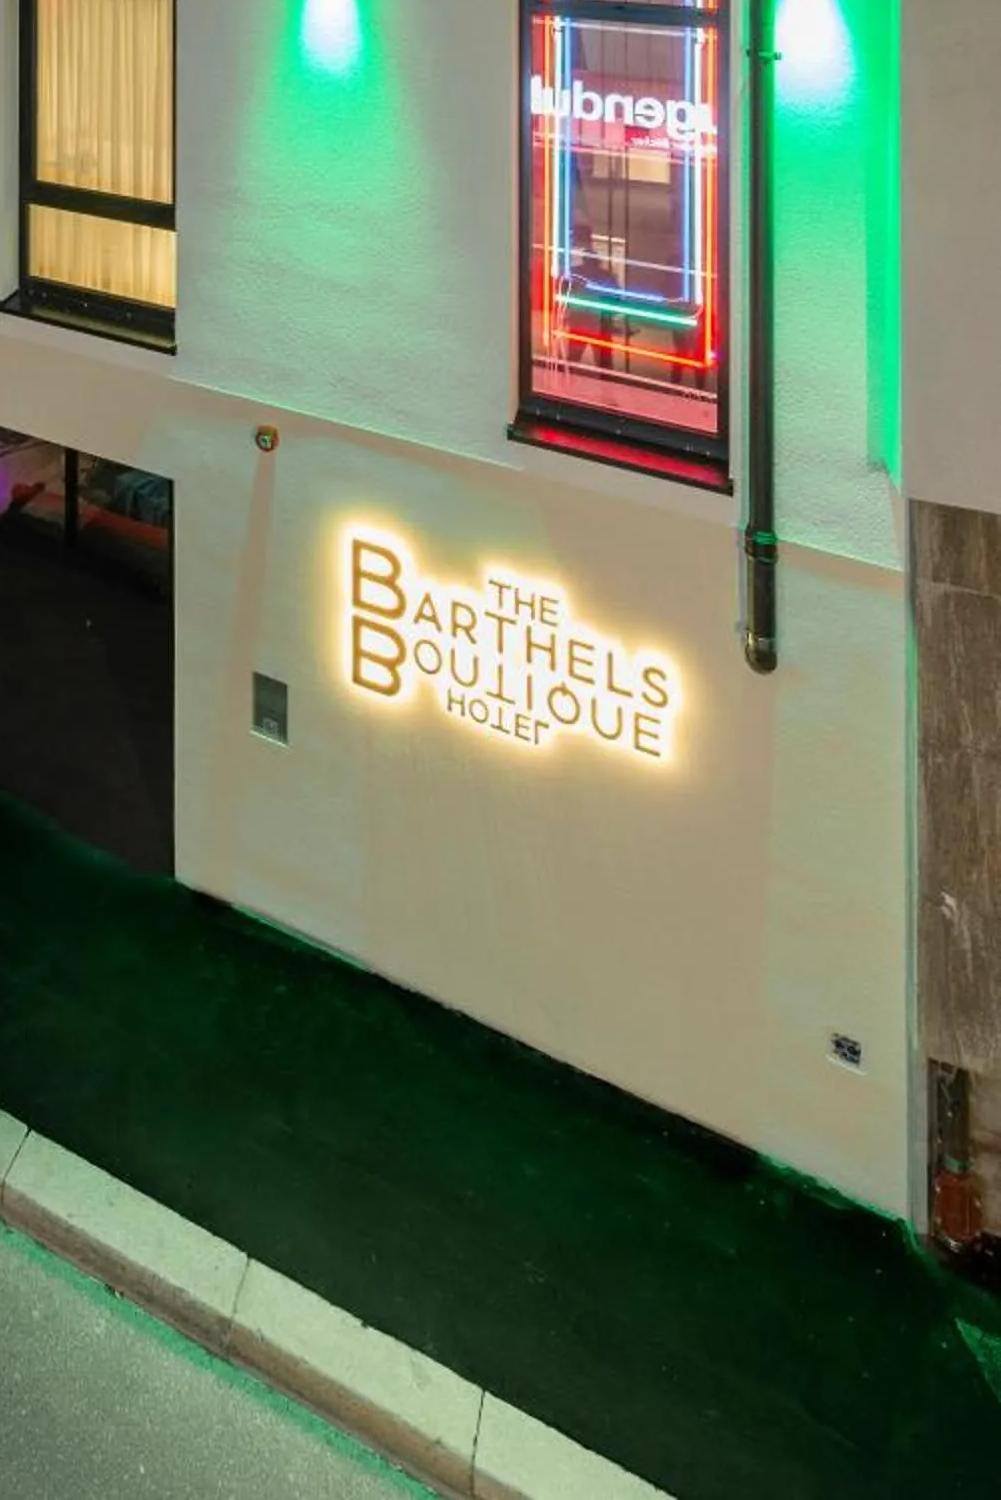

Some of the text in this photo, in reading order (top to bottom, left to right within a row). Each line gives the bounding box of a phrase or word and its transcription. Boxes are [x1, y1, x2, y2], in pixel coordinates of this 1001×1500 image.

[351, 538, 670, 709] BARTHELS
[488, 578, 560, 627] THE
[351, 613, 662, 758] BOUTIQUE
